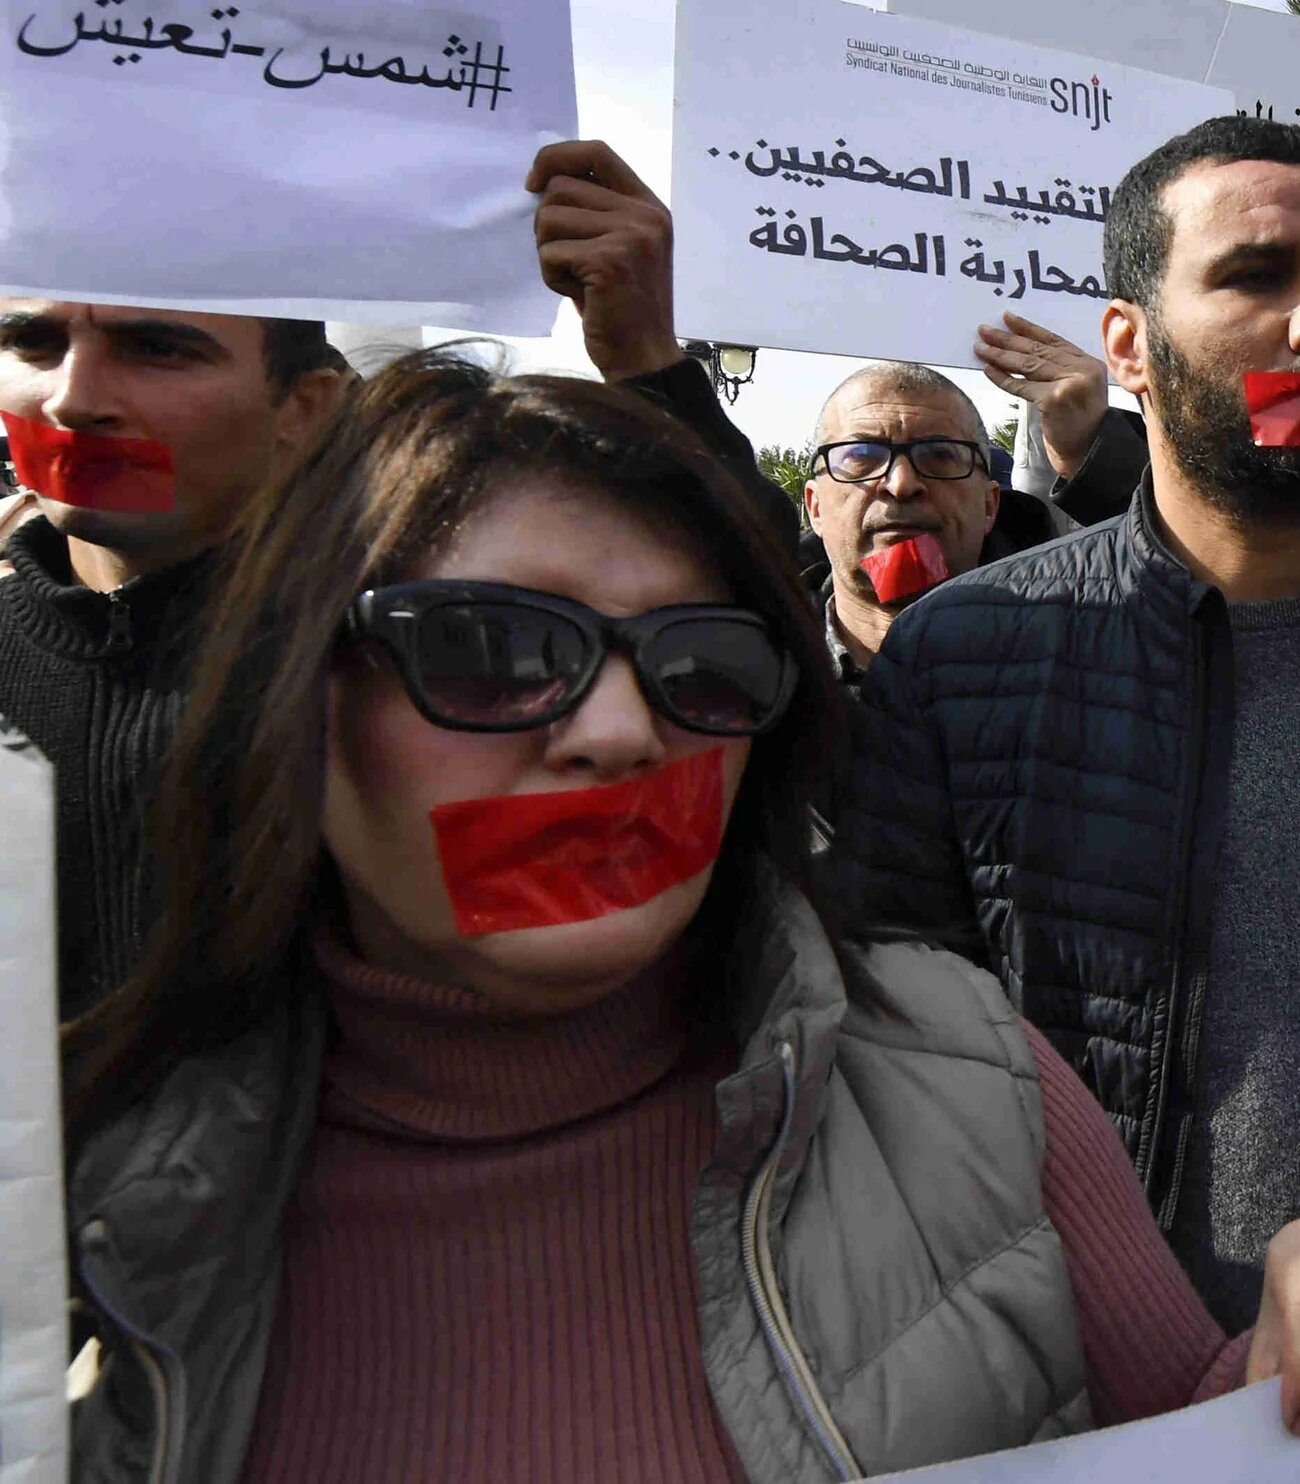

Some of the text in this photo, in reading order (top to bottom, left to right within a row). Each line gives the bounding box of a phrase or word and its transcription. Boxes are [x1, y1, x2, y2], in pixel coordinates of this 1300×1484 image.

[846, 53, 1048, 107] Syndicat National des Journalistes Tunisiens
[1050, 73, 1113, 131] snjt
[749, 205, 1109, 300] محاربة الصحافة
